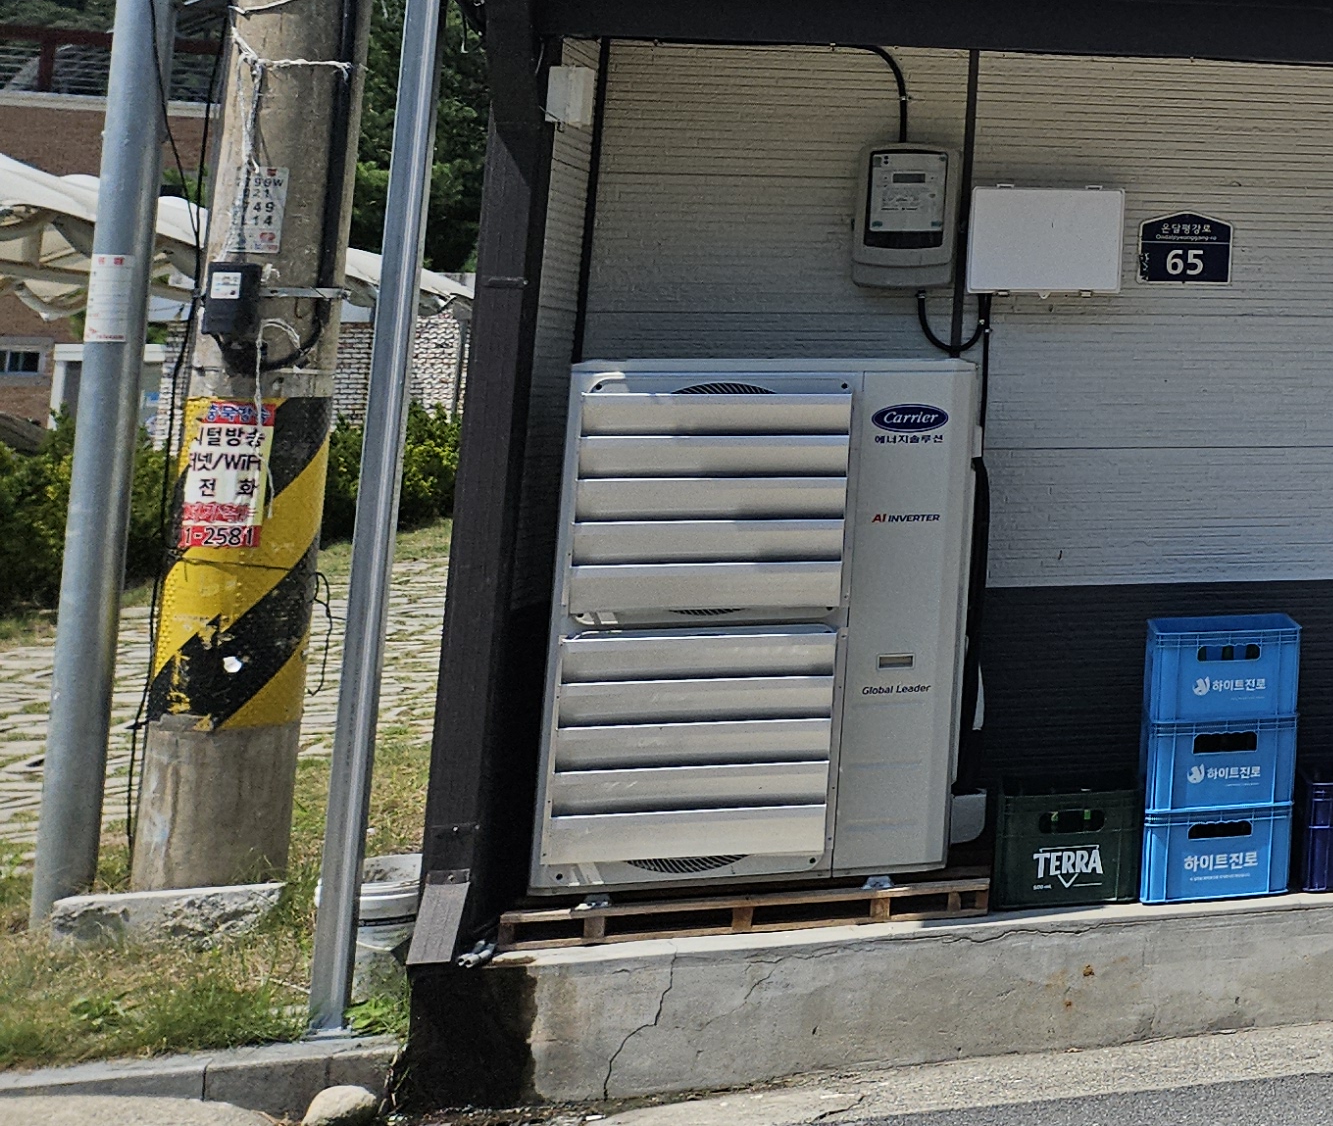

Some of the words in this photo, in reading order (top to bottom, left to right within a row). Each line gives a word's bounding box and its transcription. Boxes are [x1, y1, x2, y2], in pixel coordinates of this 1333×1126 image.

[1161, 223, 1211, 234] 온달평강로
[1166, 249, 1204, 276] 65
[883, 411, 939, 424] Carrier
[874, 434, 944, 444] 에너지솔루션
[872, 514, 887, 523] AI
[888, 514, 940, 523] INVERTER
[862, 685, 894, 695] Global
[896, 684, 932, 694] Leader
[1212, 678, 1266, 692] 하이트진로
[1206, 766, 1261, 780] 하이트진로
[1033, 849, 1103, 879] TERRA
[1184, 851, 1258, 872] 하이트진로
